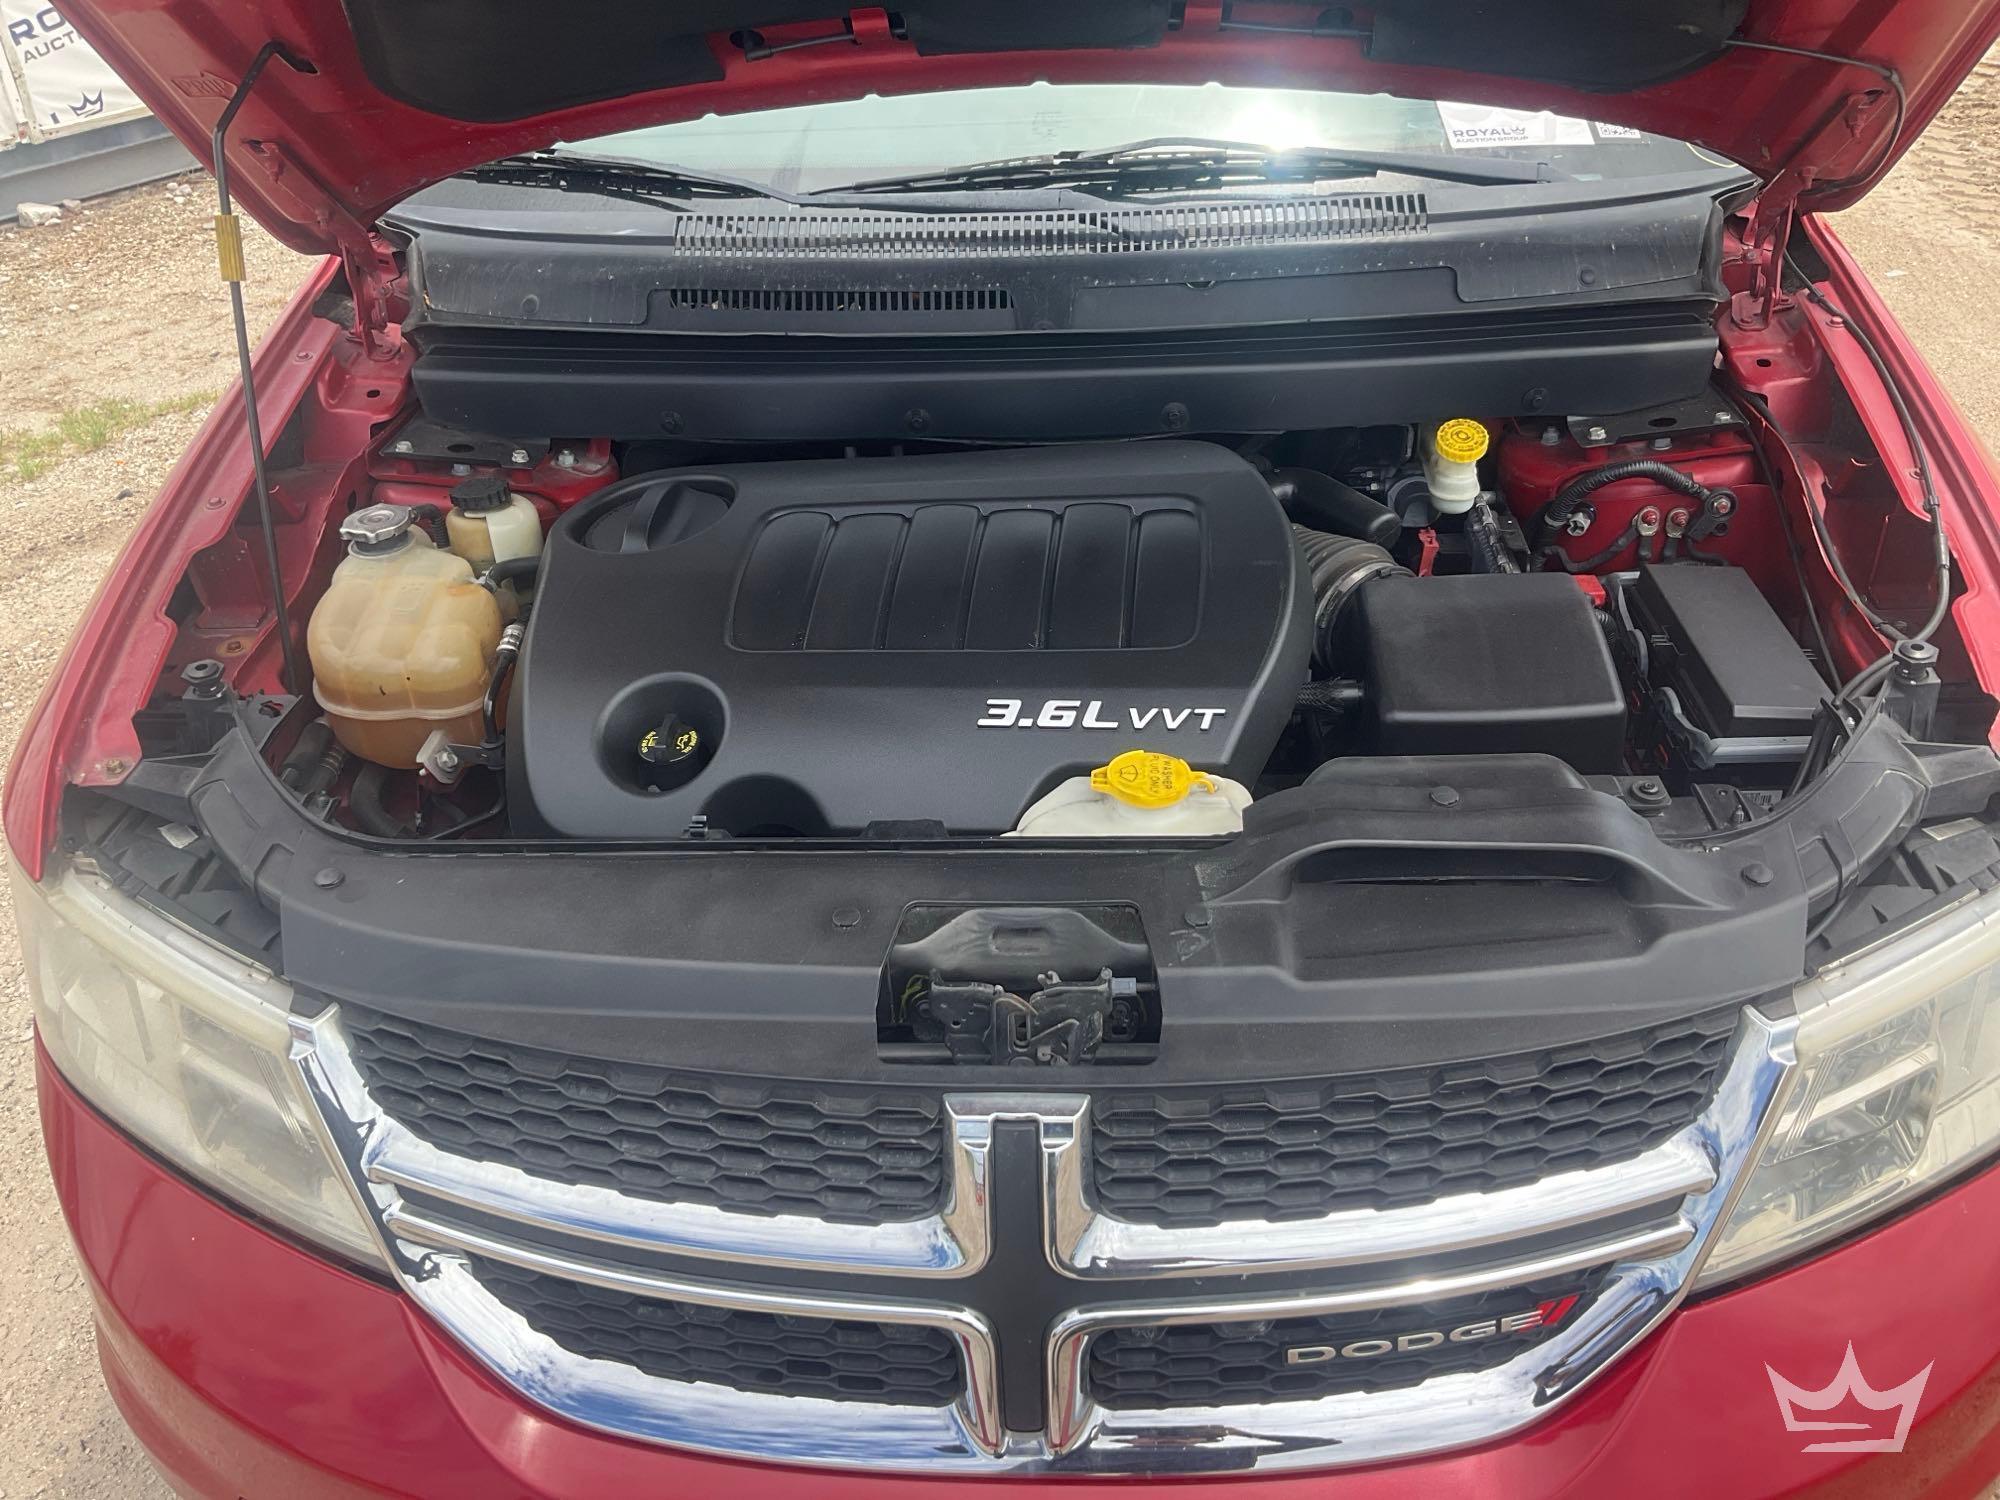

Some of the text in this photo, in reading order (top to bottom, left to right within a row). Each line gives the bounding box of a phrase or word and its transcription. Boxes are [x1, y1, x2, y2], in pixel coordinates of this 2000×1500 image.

[1453, 128, 1511, 137] ROYAL
[977, 698, 1226, 730] 3.6L VVT
[1287, 1310, 1543, 1364] DODGE
